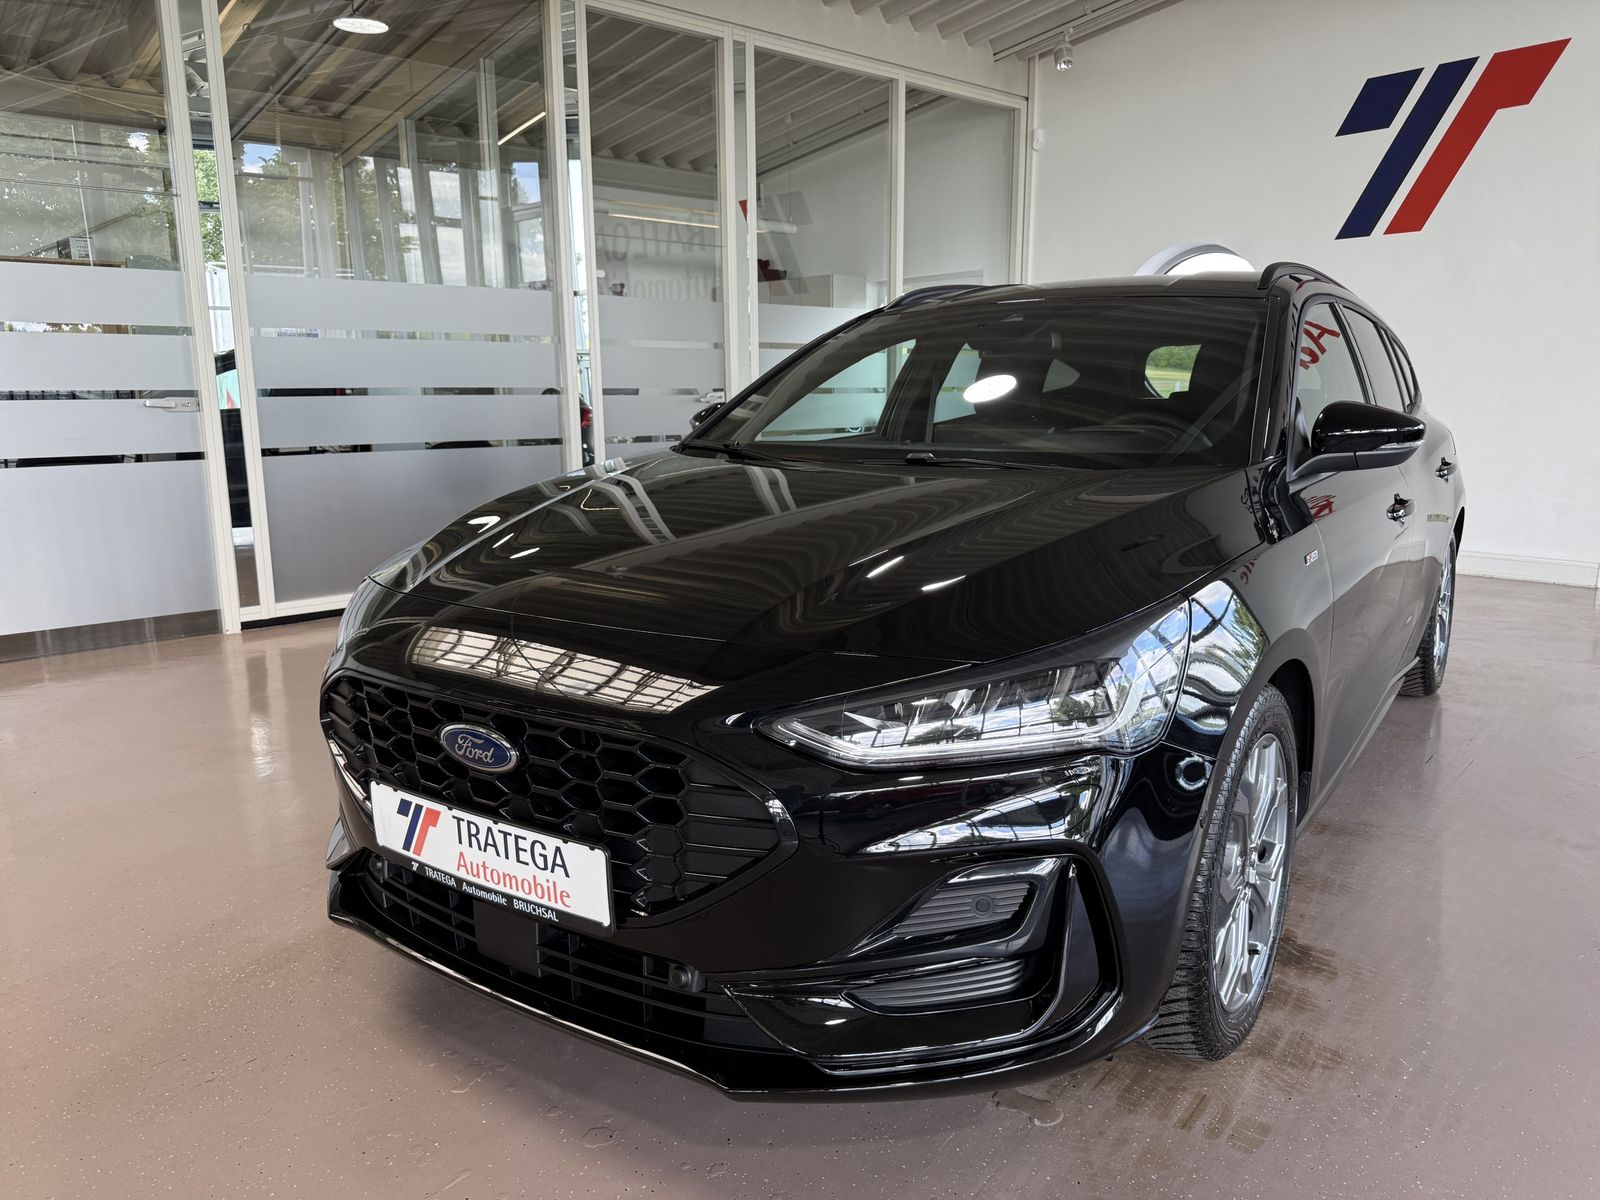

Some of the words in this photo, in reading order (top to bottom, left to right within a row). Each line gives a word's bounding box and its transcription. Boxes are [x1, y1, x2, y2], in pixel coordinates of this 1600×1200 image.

[455, 733, 495, 763] Ford
[451, 814, 570, 878] TRATEGA
[424, 866, 457, 888] TRATEGA
[462, 881, 508, 906] Automobile
[513, 898, 560, 922] BRUCHSAL
[456, 851, 572, 908] Automobile
